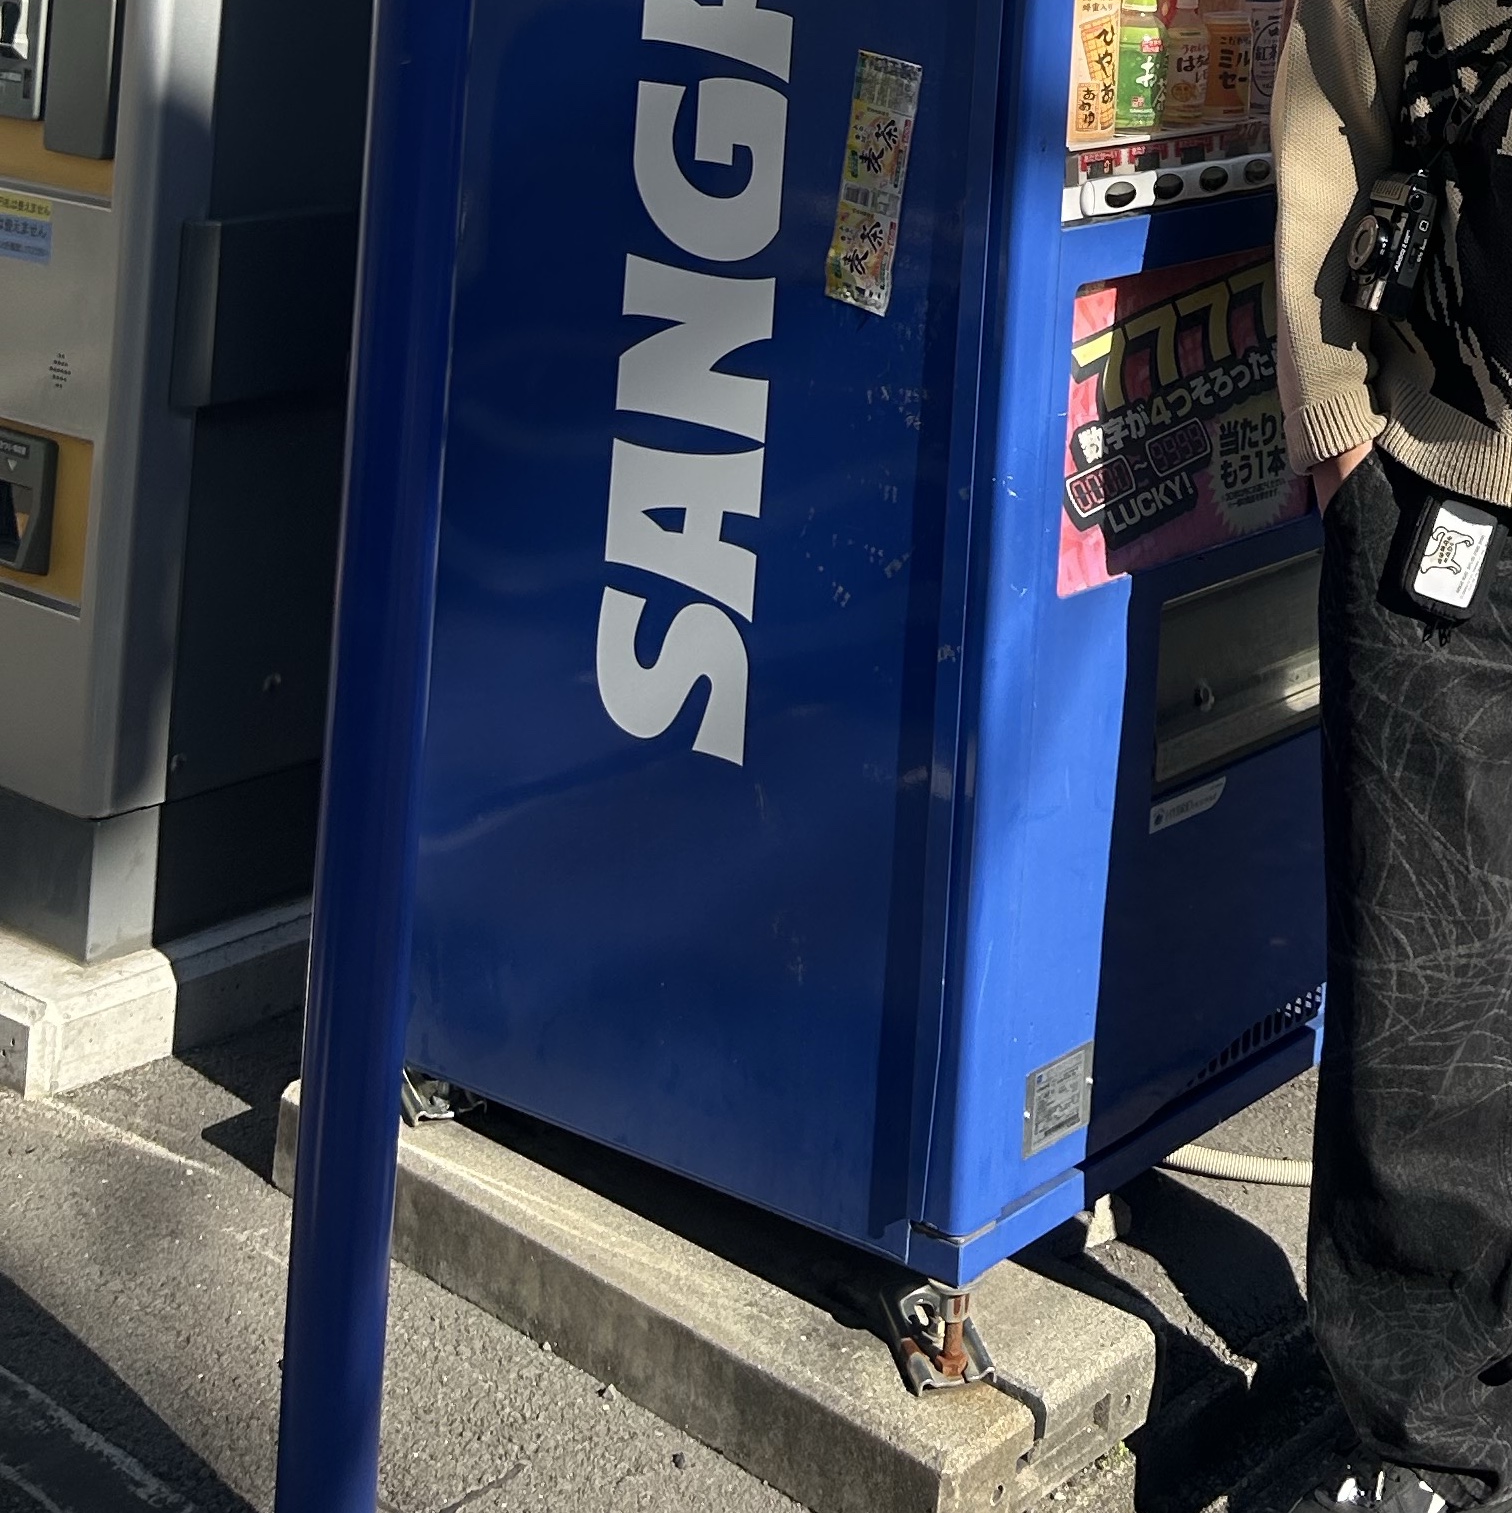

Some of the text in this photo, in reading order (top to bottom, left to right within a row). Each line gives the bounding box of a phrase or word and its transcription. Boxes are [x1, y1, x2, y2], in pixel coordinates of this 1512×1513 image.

[1070, 260, 1276, 413] 7777
[1077, 348, 1277, 464] 数字が4つそろった
[1106, 471, 1194, 535] LUCKY!
[1220, 445, 1287, 489] もう1本
